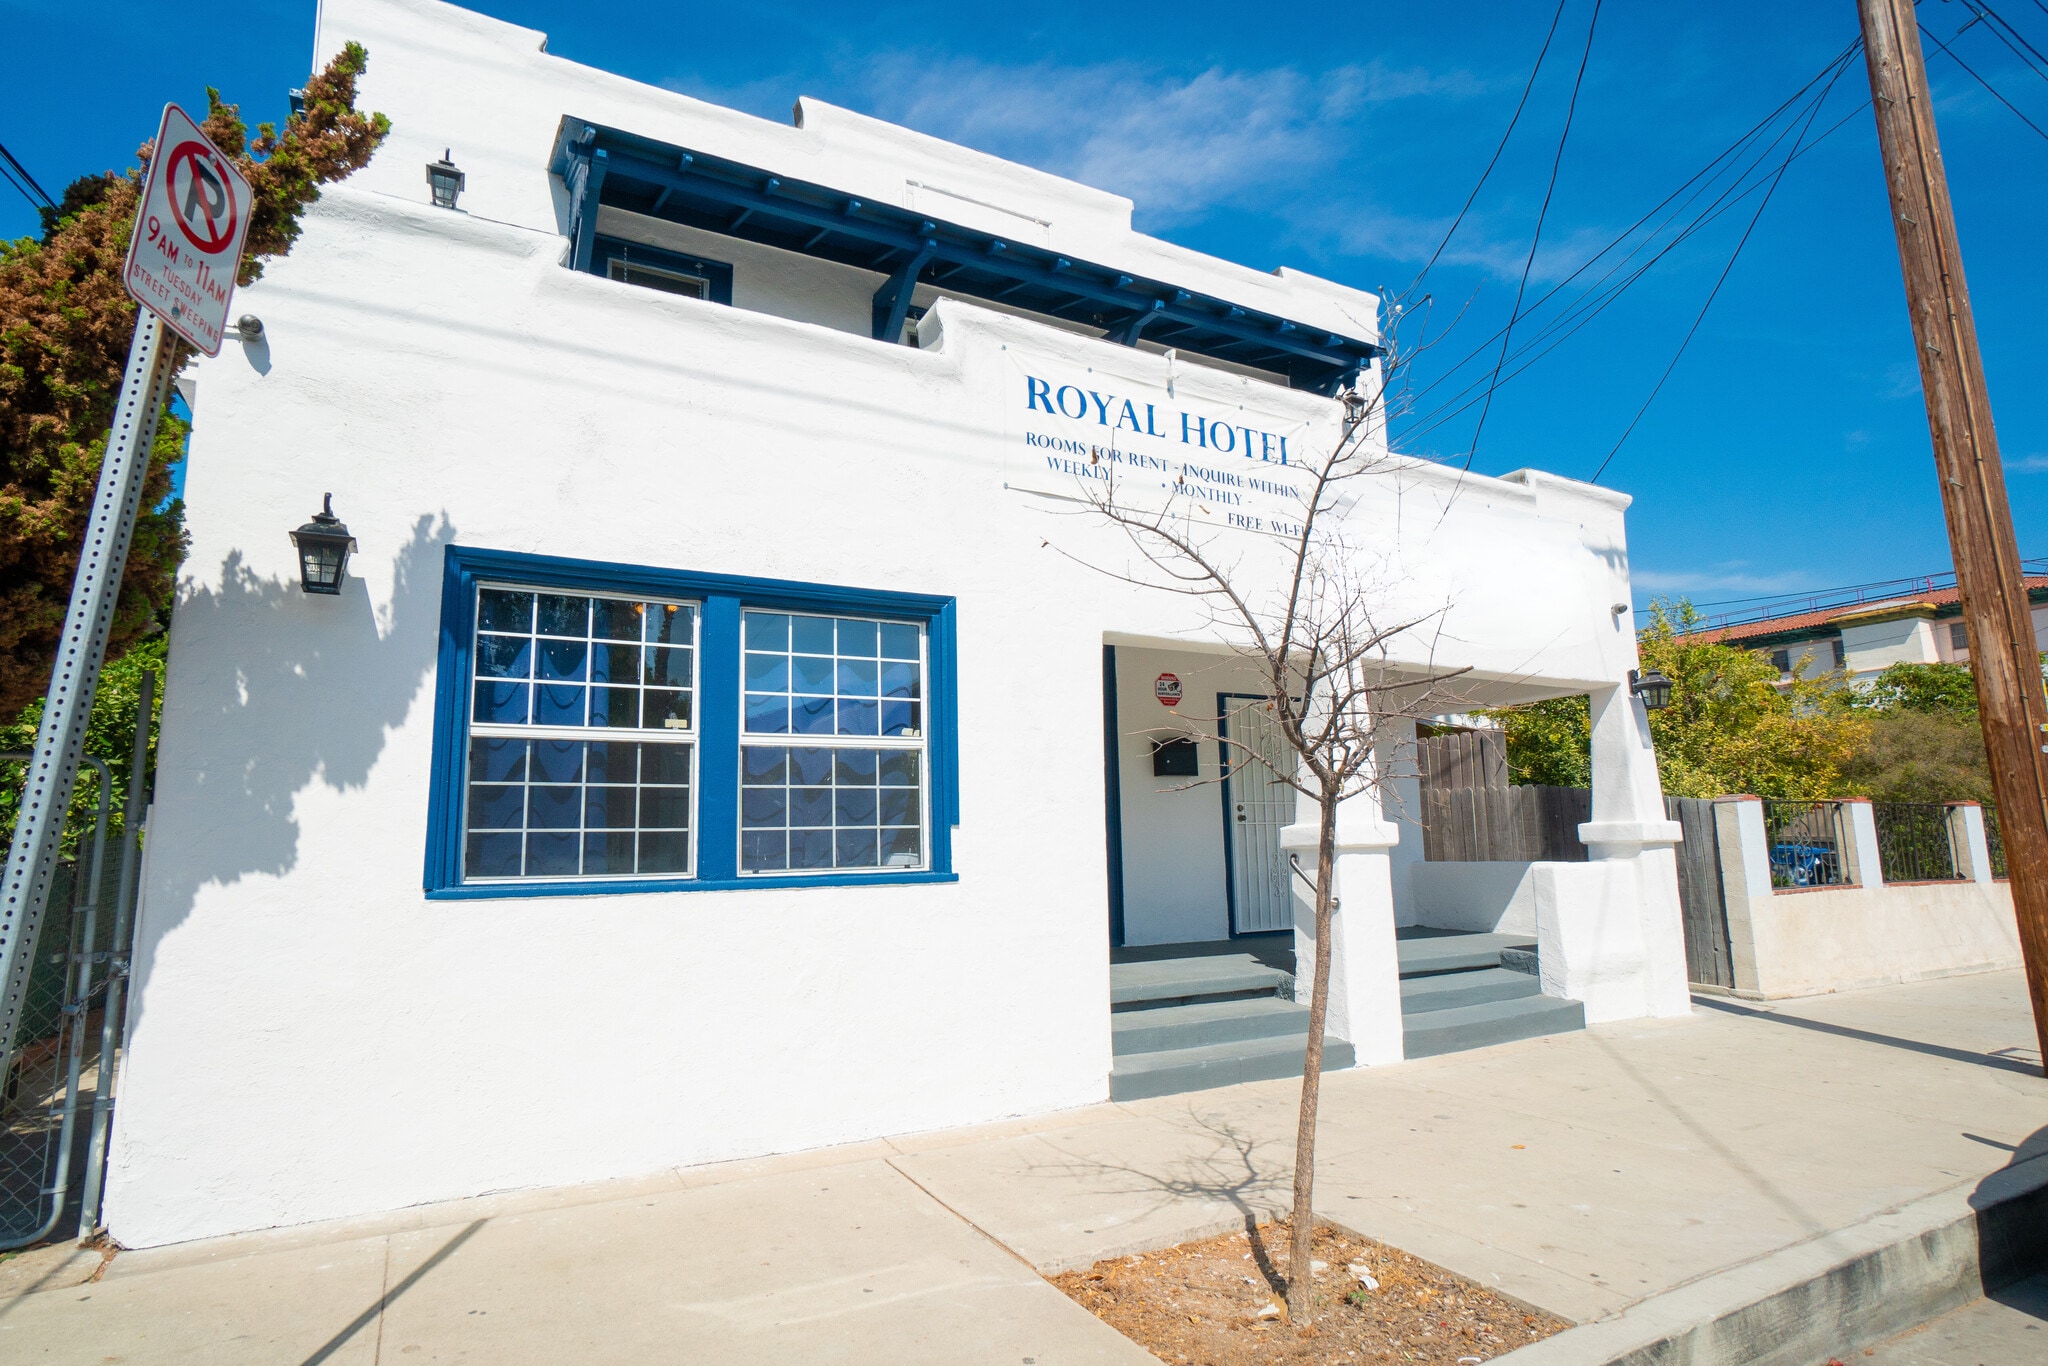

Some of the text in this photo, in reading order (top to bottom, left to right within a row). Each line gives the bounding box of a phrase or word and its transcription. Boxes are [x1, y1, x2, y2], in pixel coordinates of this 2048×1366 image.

[147, 215, 227, 307] 9AM TO 11AM
[163, 264, 203, 307] TUESDAY
[133, 263, 171, 302] STREET
[173, 296, 220, 343] SWEEPING
[1024, 374, 1297, 467] ROYAL HOTEL
[1025, 431, 1087, 456] ROOMS
[1128, 452, 1169, 472] RENT
[1184, 463, 1245, 488] INQUIRE
[1249, 477, 1300, 498] WITHIN
[1046, 456, 1112, 481] WEEKLY
[1172, 481, 1243, 506] MONTHLY
[1228, 512, 1263, 531] FREE
